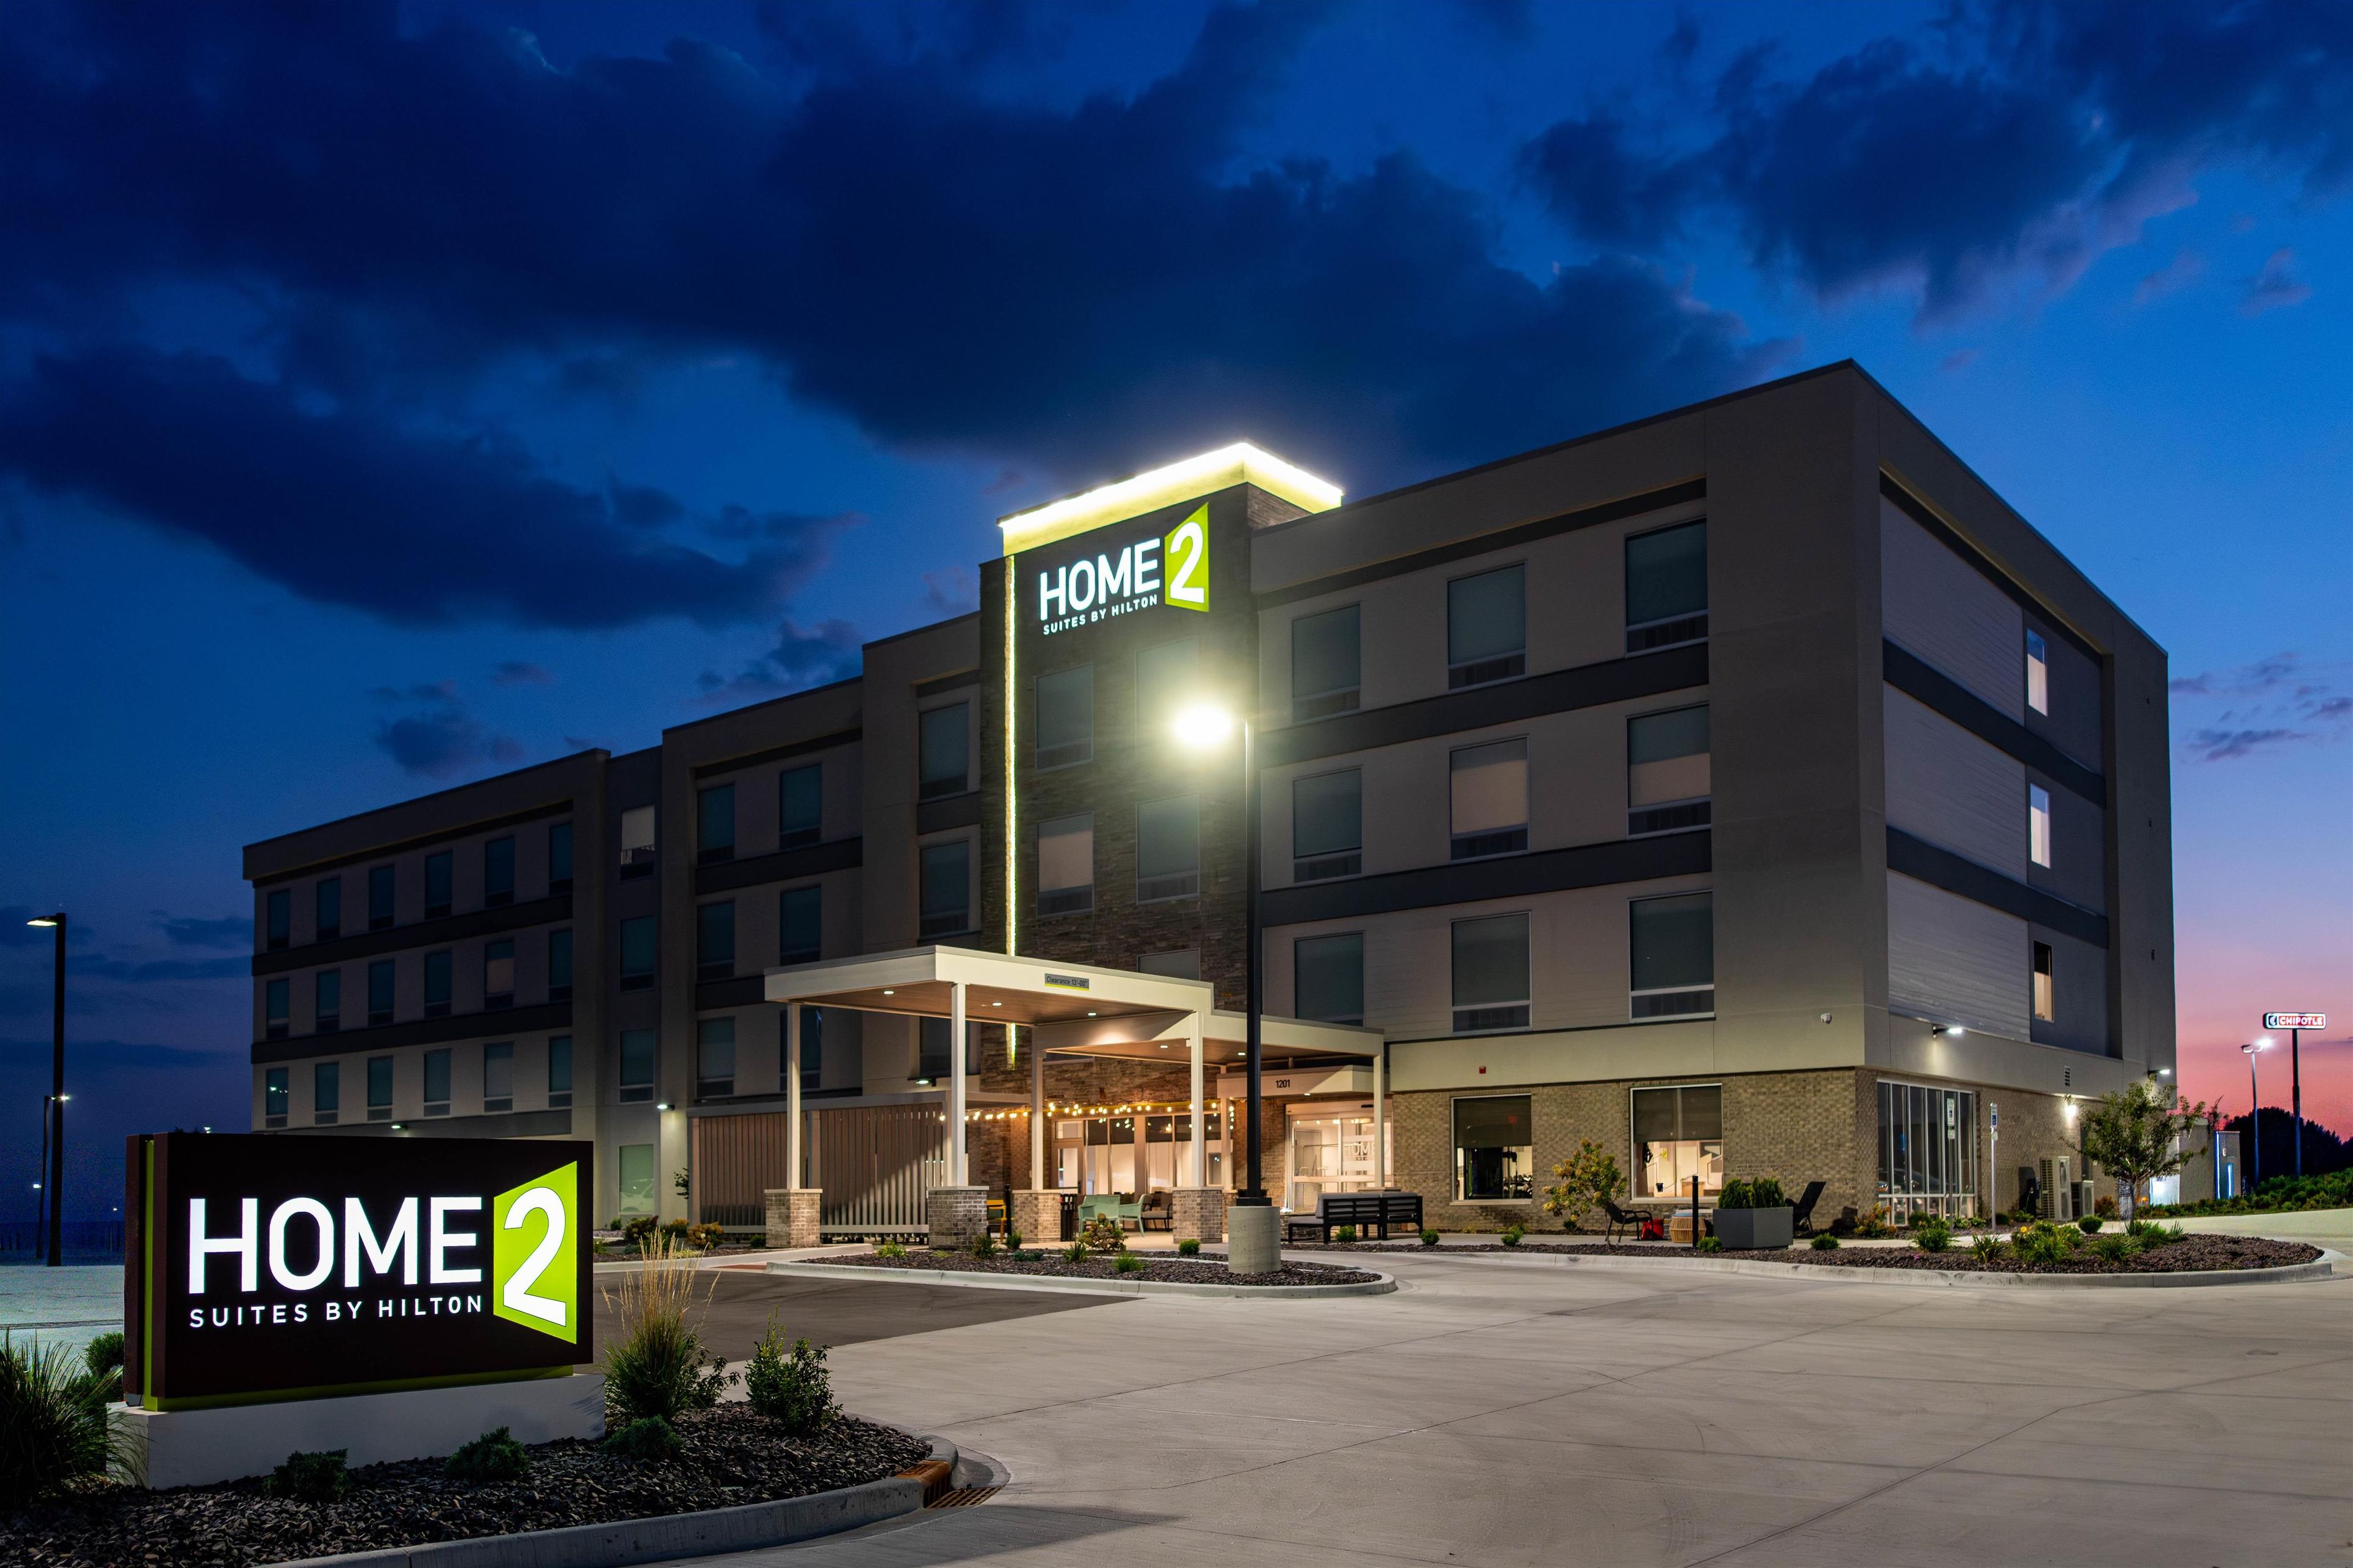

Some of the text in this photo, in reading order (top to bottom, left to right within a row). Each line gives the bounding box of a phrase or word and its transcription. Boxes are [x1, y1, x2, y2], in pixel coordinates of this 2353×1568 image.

[1043, 594, 1158, 635] SUITES BY HILTON
[1046, 976, 1070, 985] Clearance
[2279, 1016, 2323, 1025] CHIPOTLE
[1276, 1079, 1290, 1088] 1201
[189, 1295, 481, 1328] SUITES BY HILTON
